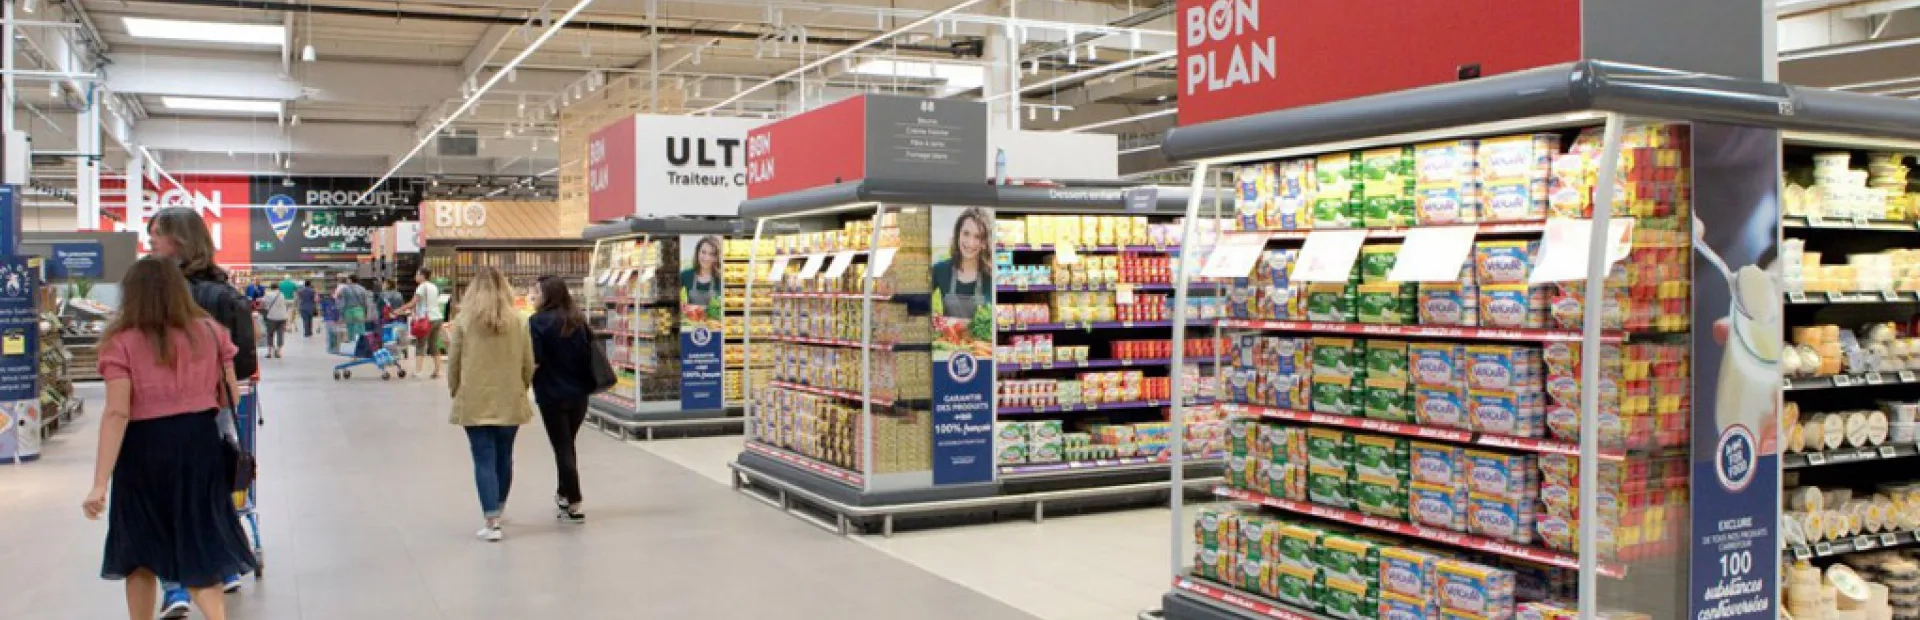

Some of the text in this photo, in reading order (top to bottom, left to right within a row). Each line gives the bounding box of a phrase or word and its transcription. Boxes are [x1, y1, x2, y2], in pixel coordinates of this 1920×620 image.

[1187, 0, 1258, 48] BON
[1187, 36, 1276, 96] PLAN
[590, 136, 606, 164] BON
[749, 132, 771, 158] BON
[590, 164, 609, 192] PLAN
[667, 171, 748, 187] Traiteur, C
[749, 158, 774, 183] PLAN
[306, 189, 393, 206] PRODUIT
[435, 201, 487, 228] BIO
[1720, 549, 1752, 577] 100
[1704, 576, 1763, 601] substances
